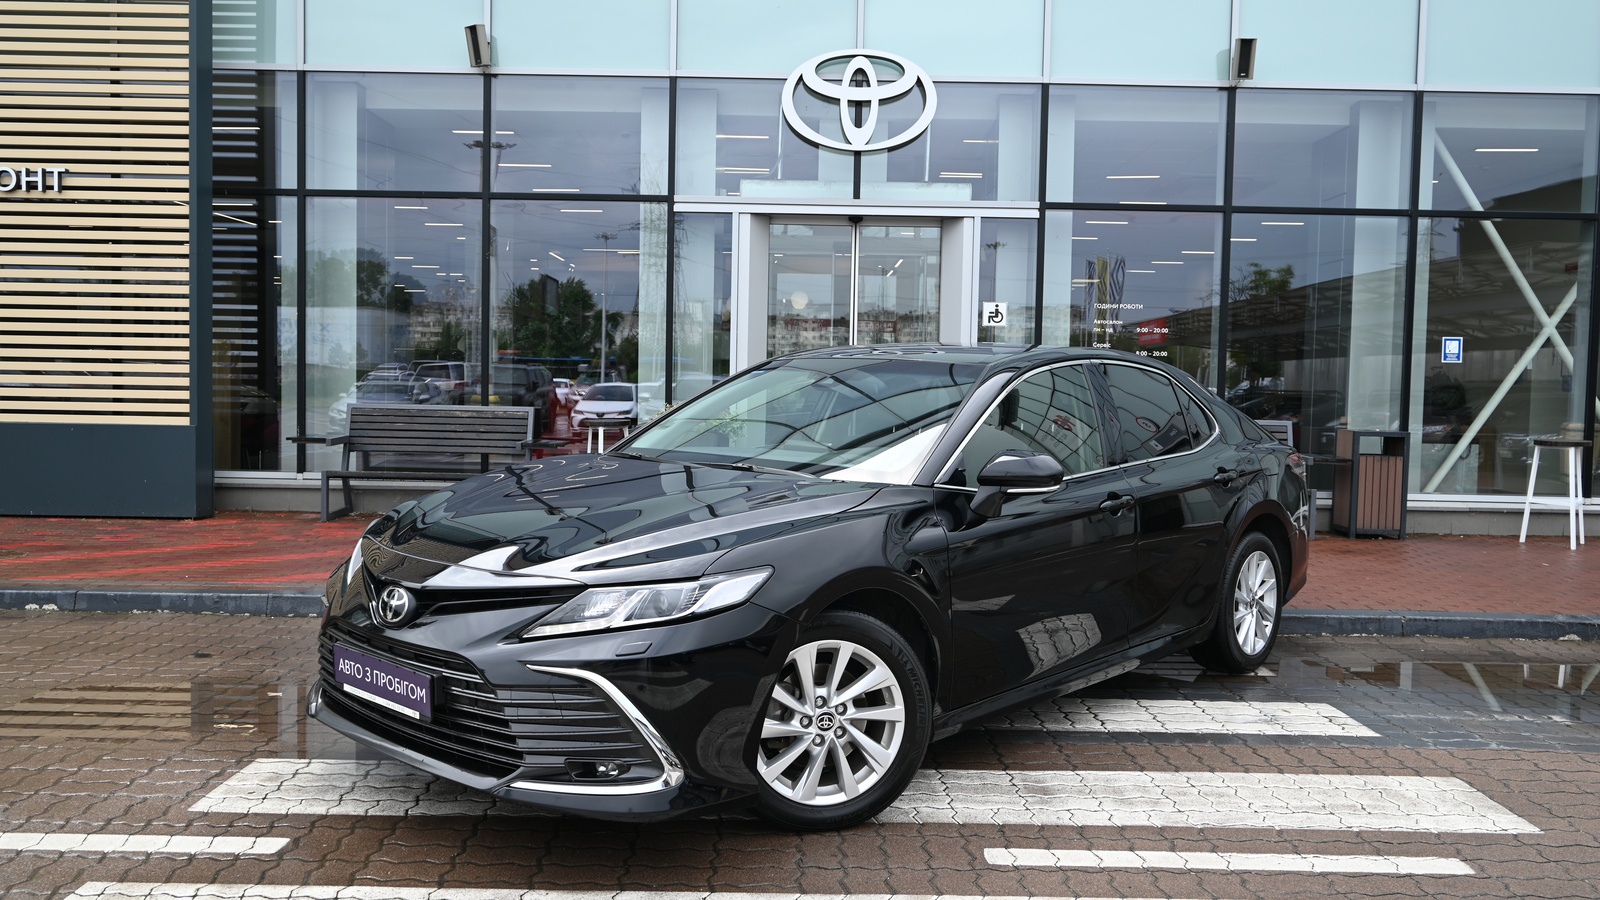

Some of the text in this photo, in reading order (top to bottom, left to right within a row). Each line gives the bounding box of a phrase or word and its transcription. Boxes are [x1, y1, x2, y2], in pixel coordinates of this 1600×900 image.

[0, 166, 66, 192] ОНТ
[338, 657, 363, 679] АВТО
[373, 669, 427, 704] ПРОБІГОМ
[906, 667, 926, 726] MICHELIN
